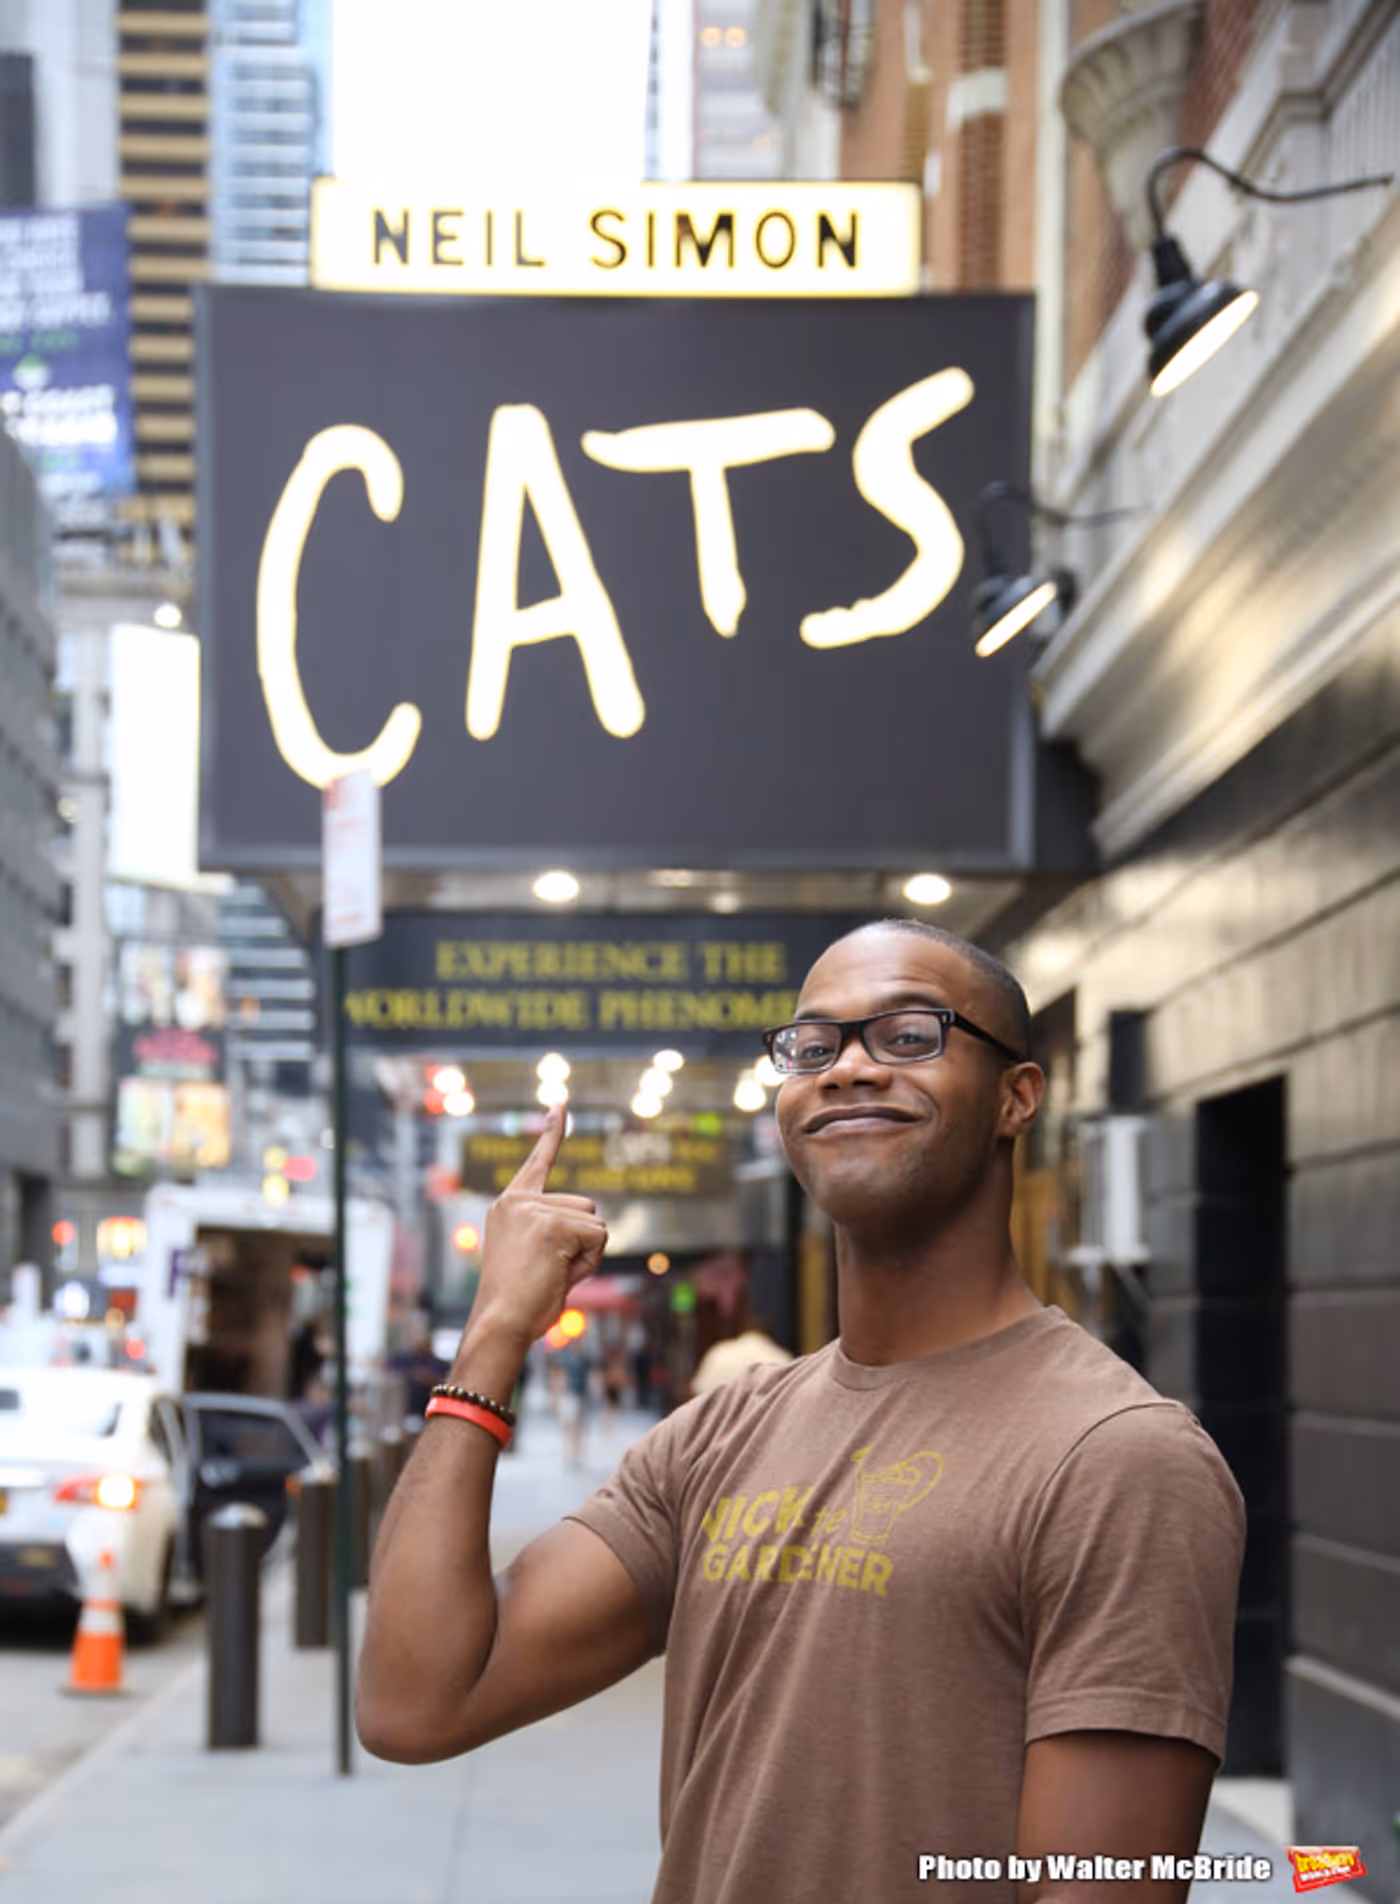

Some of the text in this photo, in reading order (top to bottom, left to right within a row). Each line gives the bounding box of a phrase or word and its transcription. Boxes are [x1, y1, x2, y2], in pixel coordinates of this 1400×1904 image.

[372, 208, 861, 270] NEIL SIMON
[256, 366, 975, 790] CATS
[435, 939, 787, 984] EXPERIENCE THE
